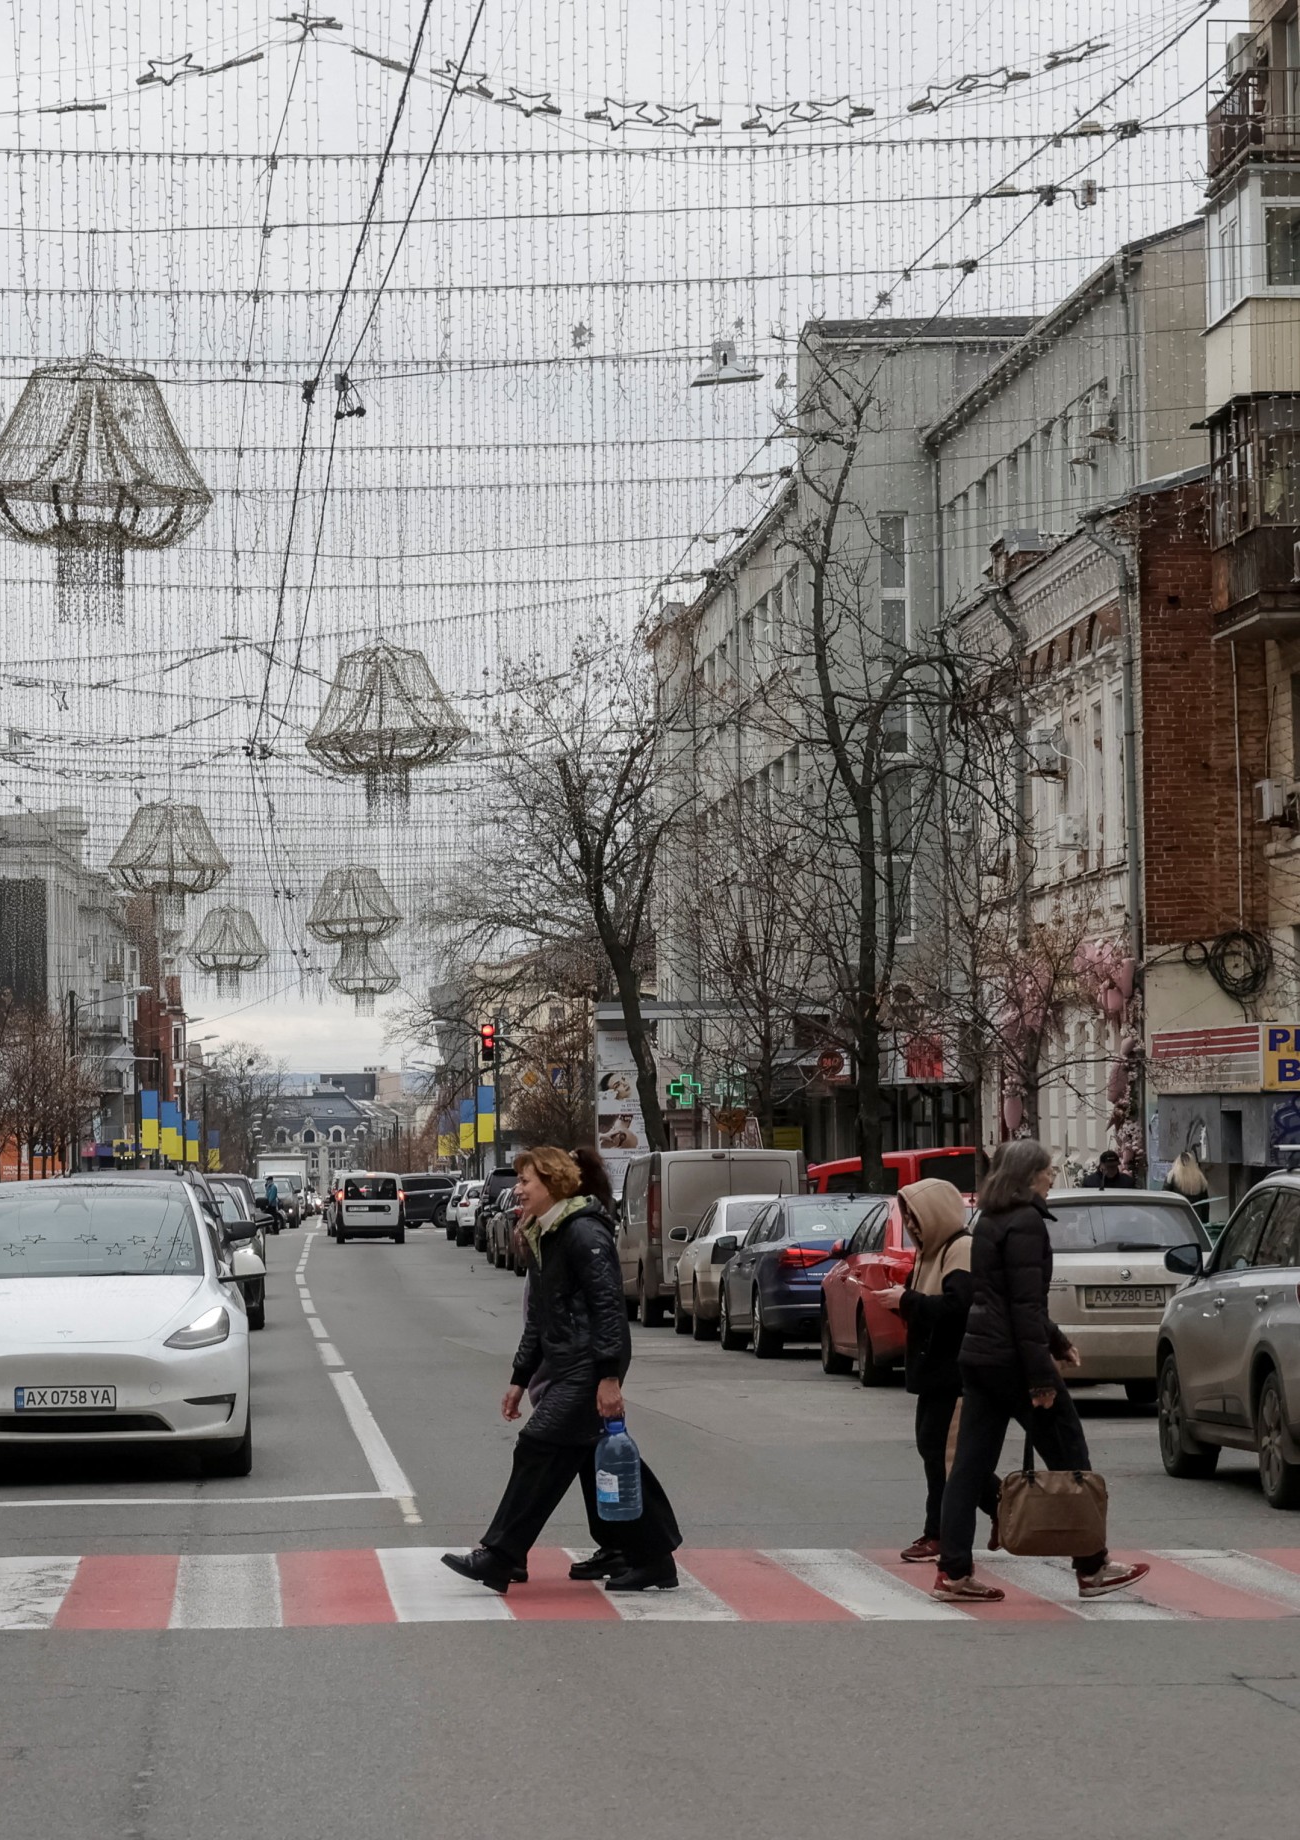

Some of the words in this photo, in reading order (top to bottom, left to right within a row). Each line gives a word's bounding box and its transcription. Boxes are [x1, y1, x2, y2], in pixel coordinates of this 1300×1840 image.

[1268, 1028, 1300, 1052] Р
[1094, 1290, 1111, 1302] AX
[1113, 1290, 1141, 1302] 9280
[1144, 1289, 1162, 1302] EA
[26, 1390, 48, 1406] AX
[51, 1390, 87, 1405] 0758
[90, 1389, 111, 1405] YA
